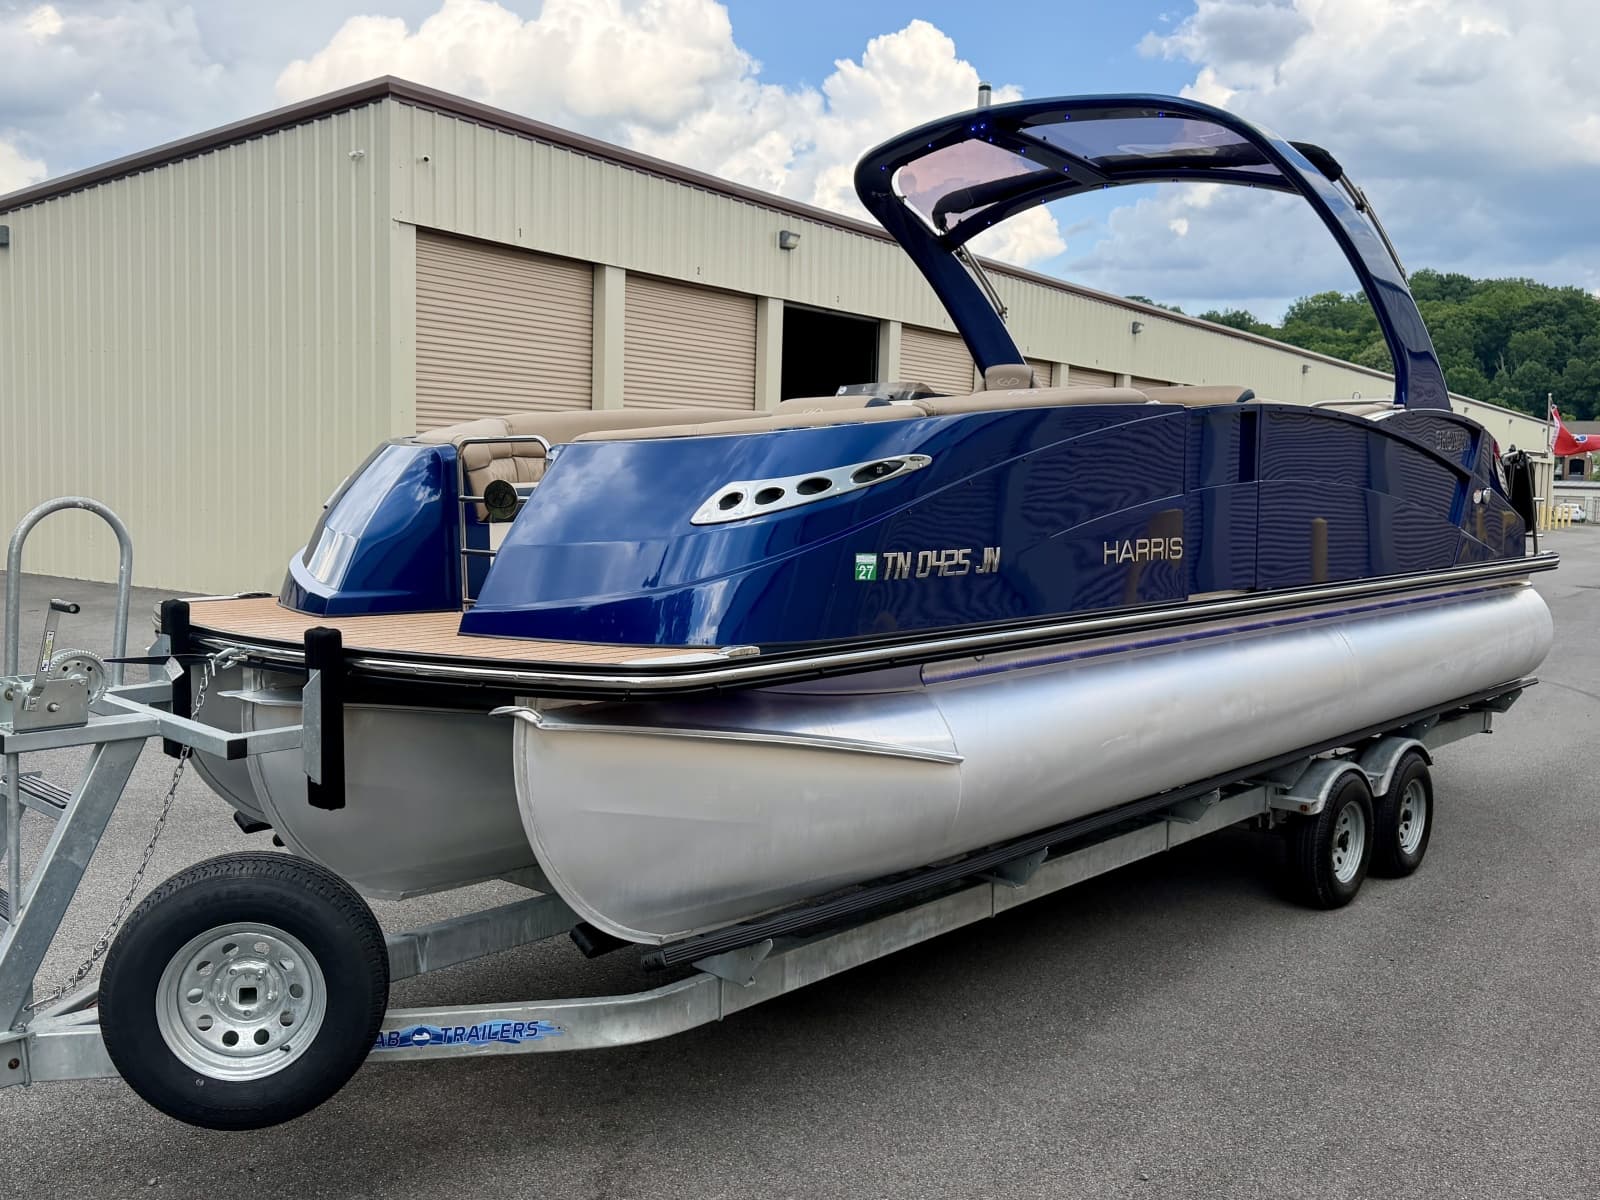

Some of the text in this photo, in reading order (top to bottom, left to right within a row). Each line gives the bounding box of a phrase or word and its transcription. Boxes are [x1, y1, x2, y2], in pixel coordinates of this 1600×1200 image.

[883, 547, 1001, 580] TN 0425 JN
[1103, 537, 1184, 565] HARRIS
[858, 565, 873, 580] 27
[440, 1021, 539, 1043] TRAILERS
